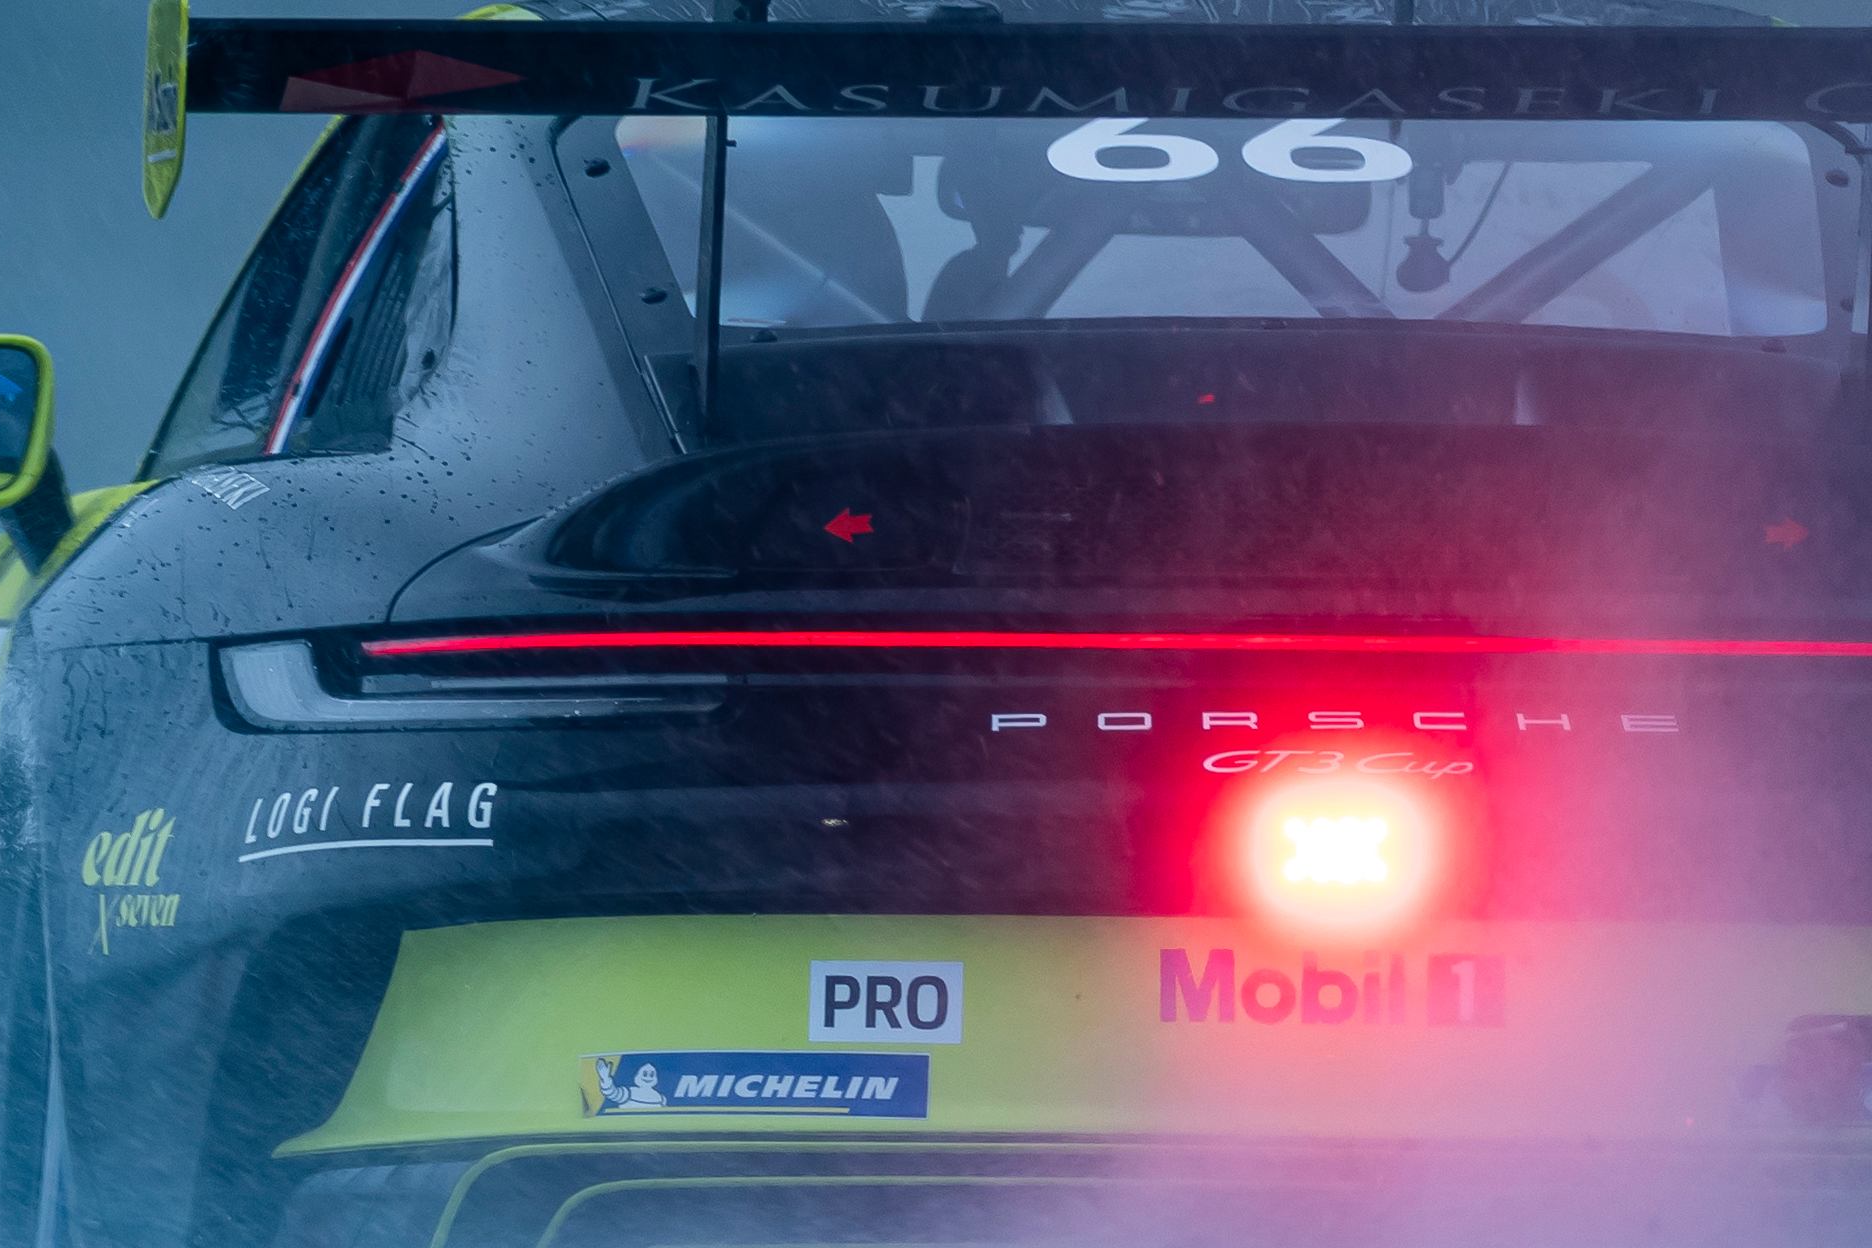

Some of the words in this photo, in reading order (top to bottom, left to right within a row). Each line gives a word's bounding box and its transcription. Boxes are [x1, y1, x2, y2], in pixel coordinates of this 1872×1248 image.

[631, 77, 1721, 115] KASUMIGASEKI
[1046, 117, 1413, 182] 66
[990, 711, 1679, 732] PORSCHE
[1356, 751, 1475, 780] Cup
[244, 786, 340, 844] LOGI
[361, 782, 499, 829] FLAG
[81, 808, 177, 887] edit
[115, 894, 180, 927] seven
[823, 975, 950, 1030] PRO
[1159, 948, 1405, 1026] Mobil
[1450, 960, 1479, 1022] 1
[673, 1074, 899, 1100] MICHELIN
